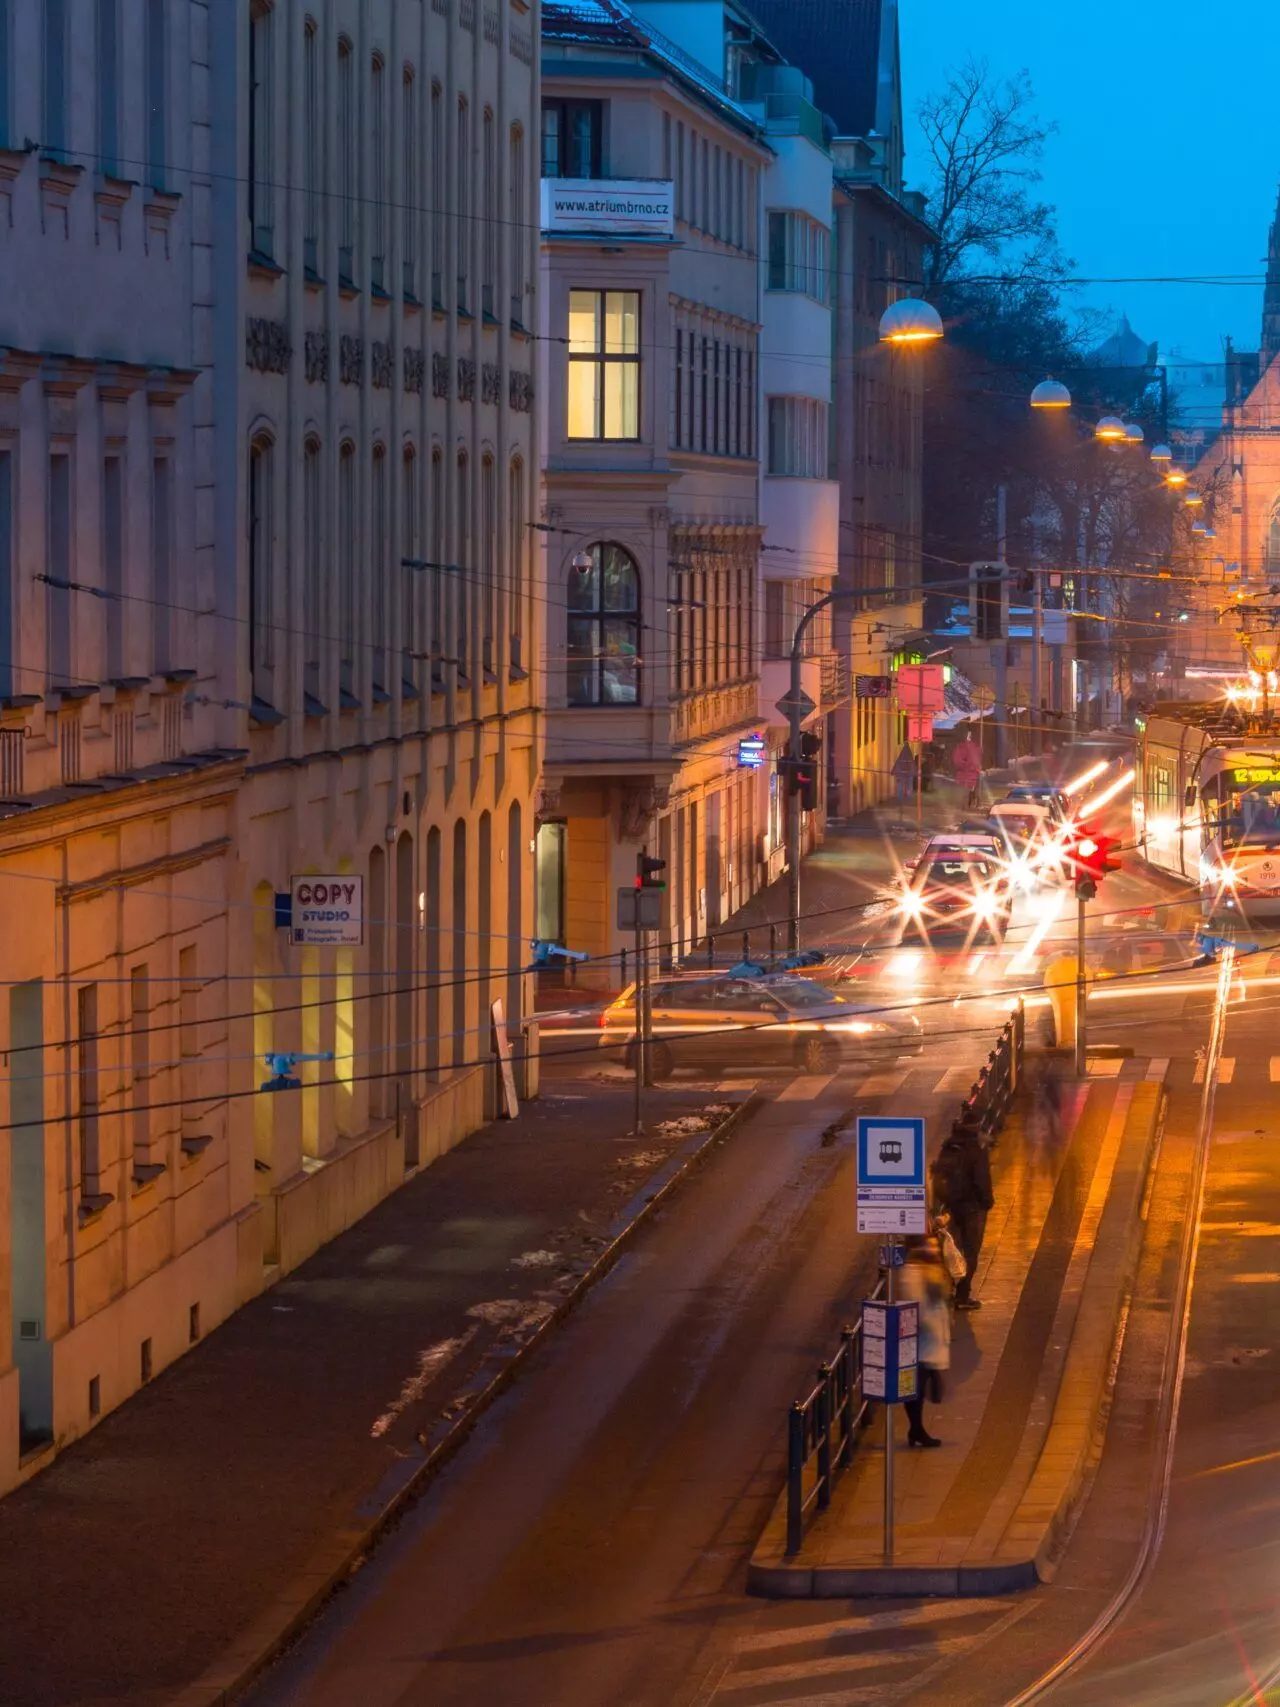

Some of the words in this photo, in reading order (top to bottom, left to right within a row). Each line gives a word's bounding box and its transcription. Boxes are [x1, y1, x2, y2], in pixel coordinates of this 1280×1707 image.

[554, 200, 669, 215] www.atriumbrno.cz
[1260, 872, 1276, 880] 1919
[297, 883, 356, 906] COPY
[302, 910, 350, 921] STUDIO
